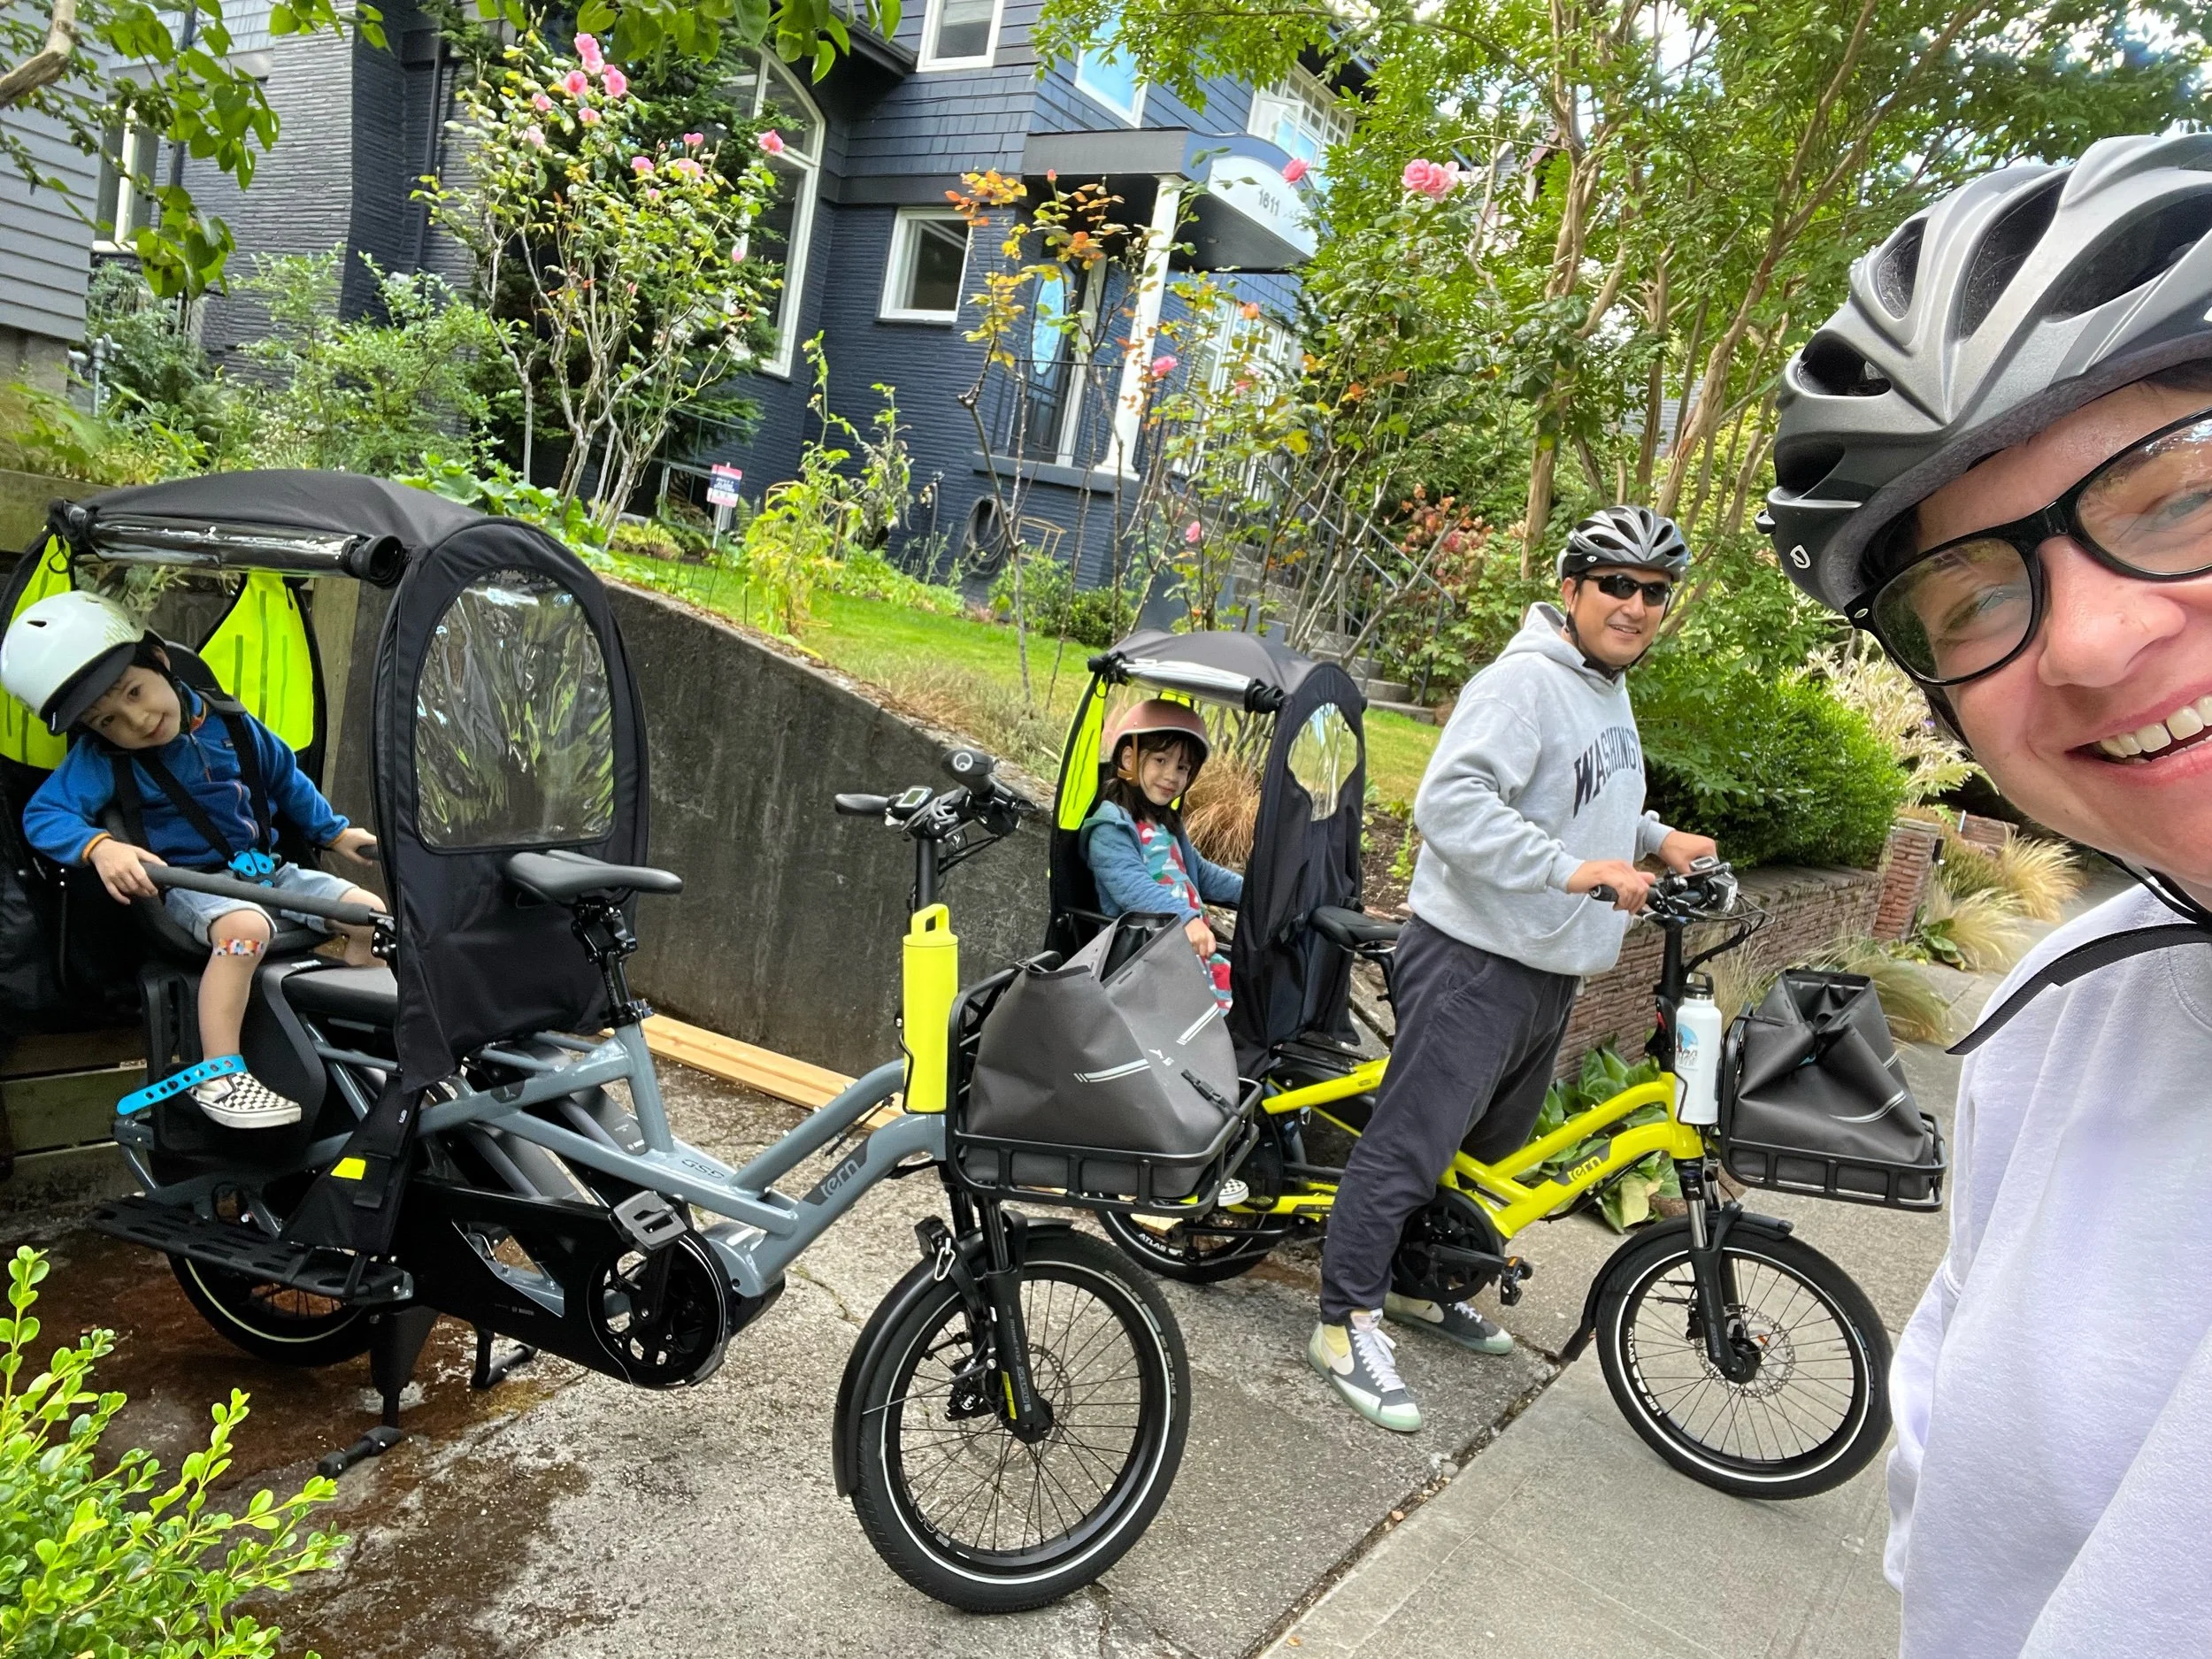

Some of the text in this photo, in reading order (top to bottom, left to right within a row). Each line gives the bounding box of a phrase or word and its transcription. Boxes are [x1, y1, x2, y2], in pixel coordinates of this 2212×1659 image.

[1258, 188, 1280, 217] 1811
[681, 1159, 725, 1179] GSD
[1139, 1233, 1167, 1252] ATLAS
[1627, 1326, 1636, 1363] ATLAS
